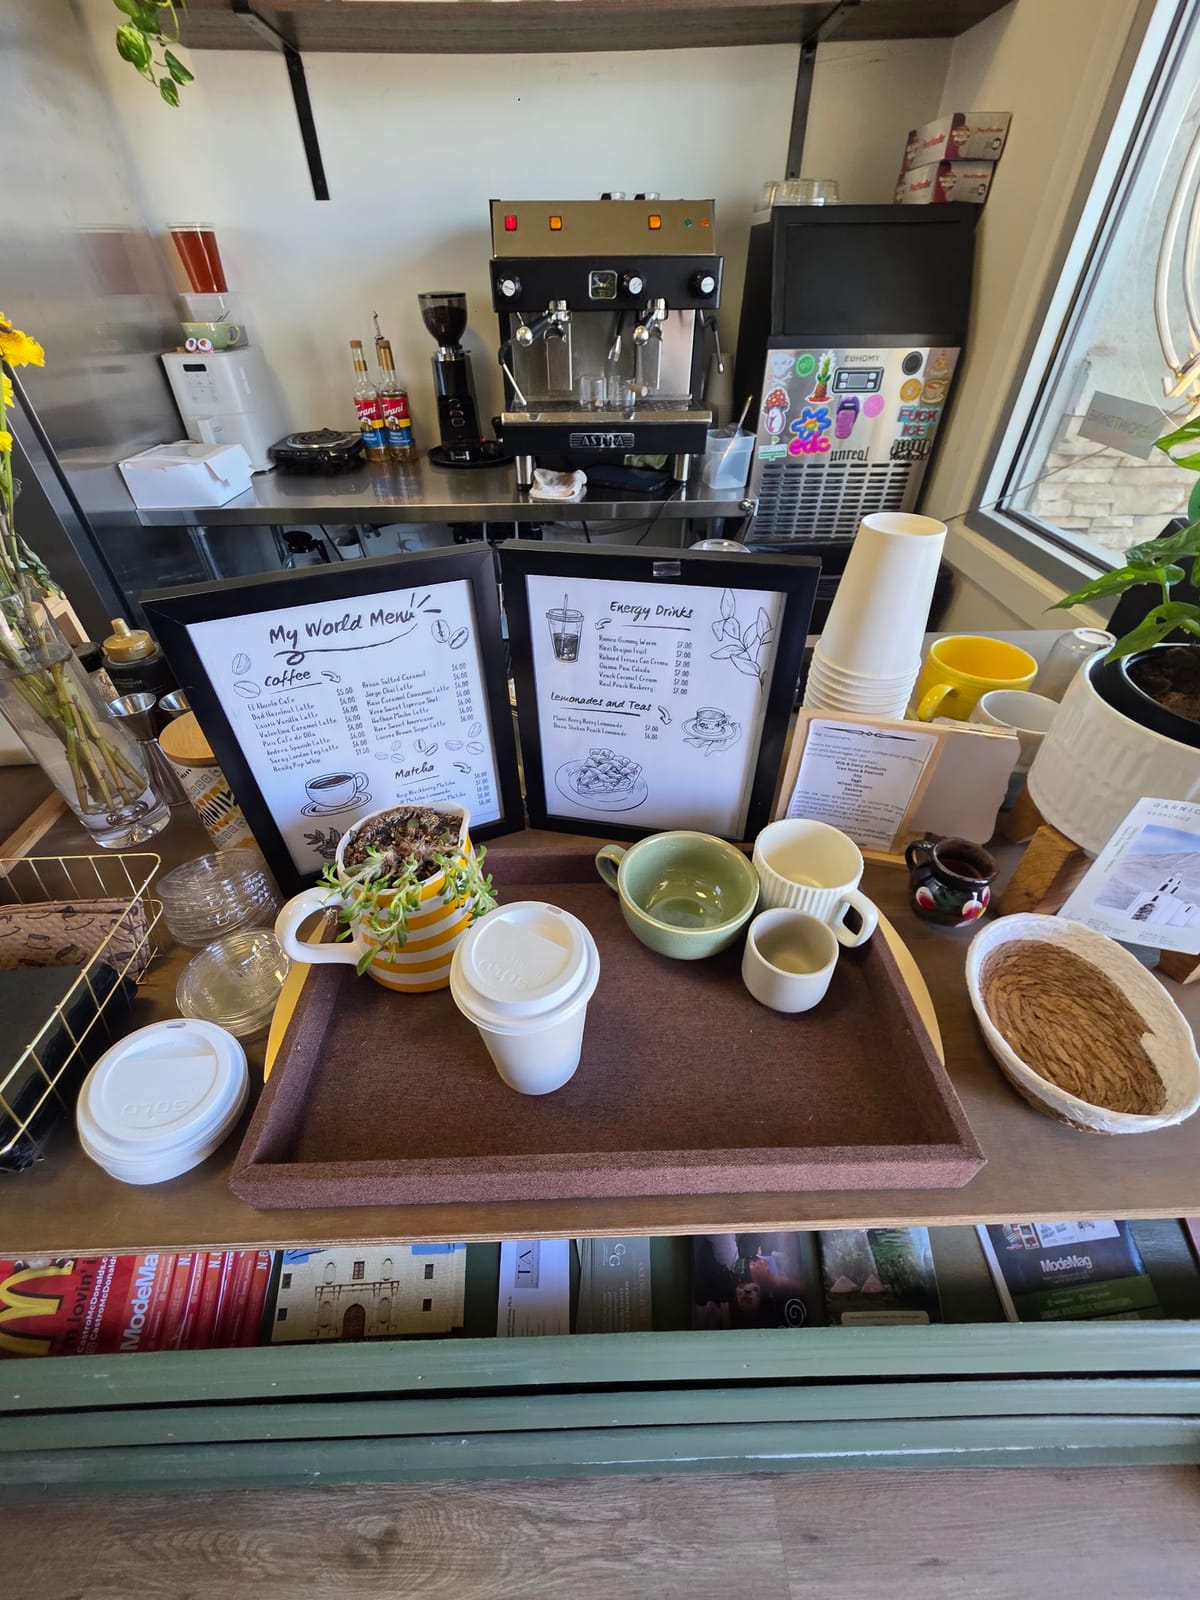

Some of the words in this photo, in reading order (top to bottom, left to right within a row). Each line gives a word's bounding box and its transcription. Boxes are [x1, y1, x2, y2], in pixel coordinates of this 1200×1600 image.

[897, 406, 939, 422] FUCK
[901, 423, 926, 437] ICE
[582, 434, 624, 448] ASTRA
[610, 601, 650, 621] Energy
[656, 605, 693, 619] Drinks
[269, 626, 298, 649] My
[305, 614, 362, 638] World
[370, 609, 416, 627] Menu
[551, 692, 603, 706] Lemonades
[629, 700, 651, 711] Teas
[395, 762, 434, 779] Matcha
[1040, 1254, 1093, 1273] ModeMag
